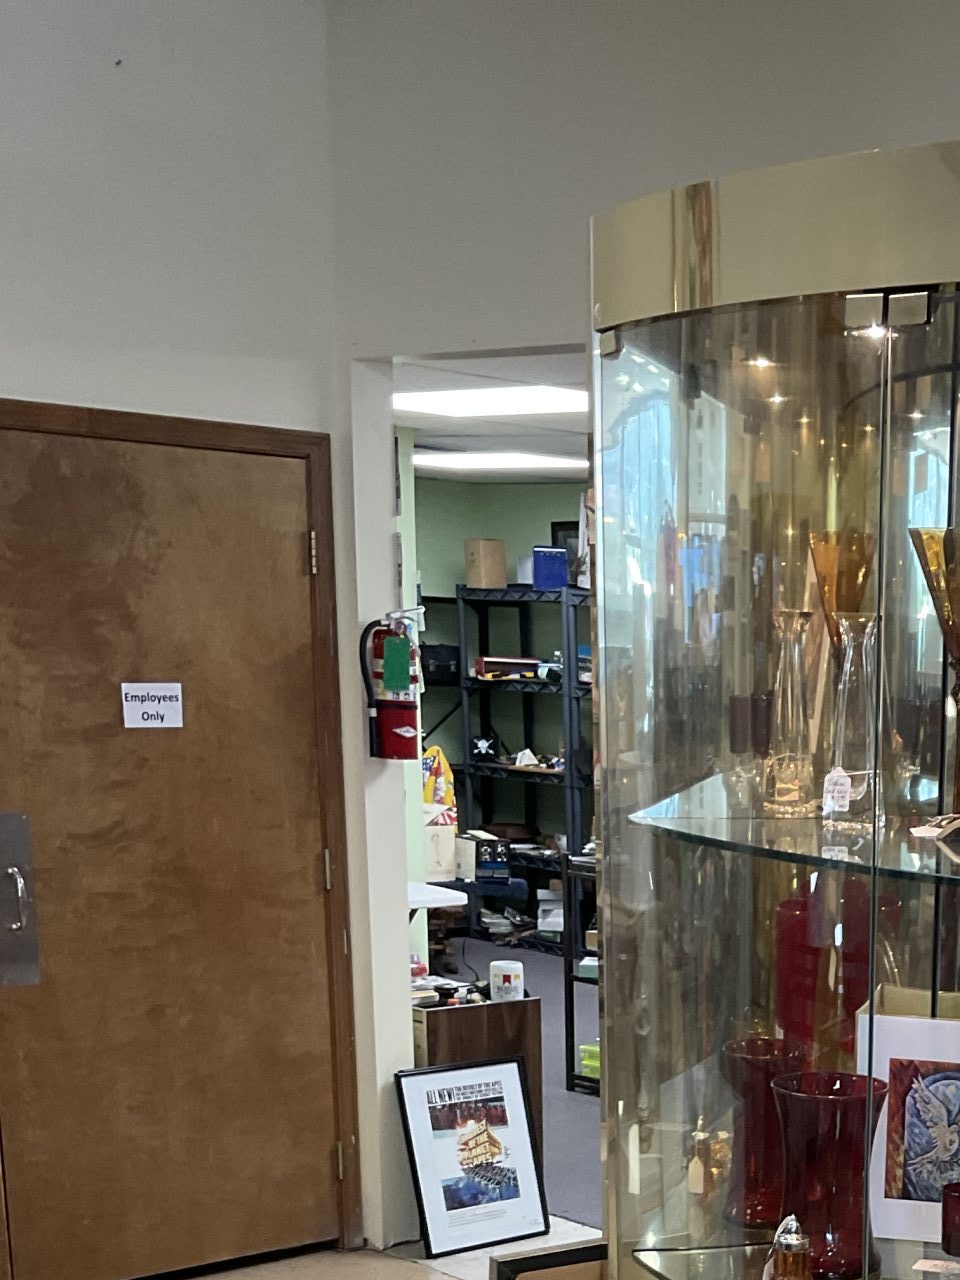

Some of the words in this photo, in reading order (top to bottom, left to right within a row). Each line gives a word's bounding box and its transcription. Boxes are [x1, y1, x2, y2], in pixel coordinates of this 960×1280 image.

[124, 692, 179, 704] Employees
[141, 711, 165, 723] Only
[426, 1090, 438, 1104] ALL
